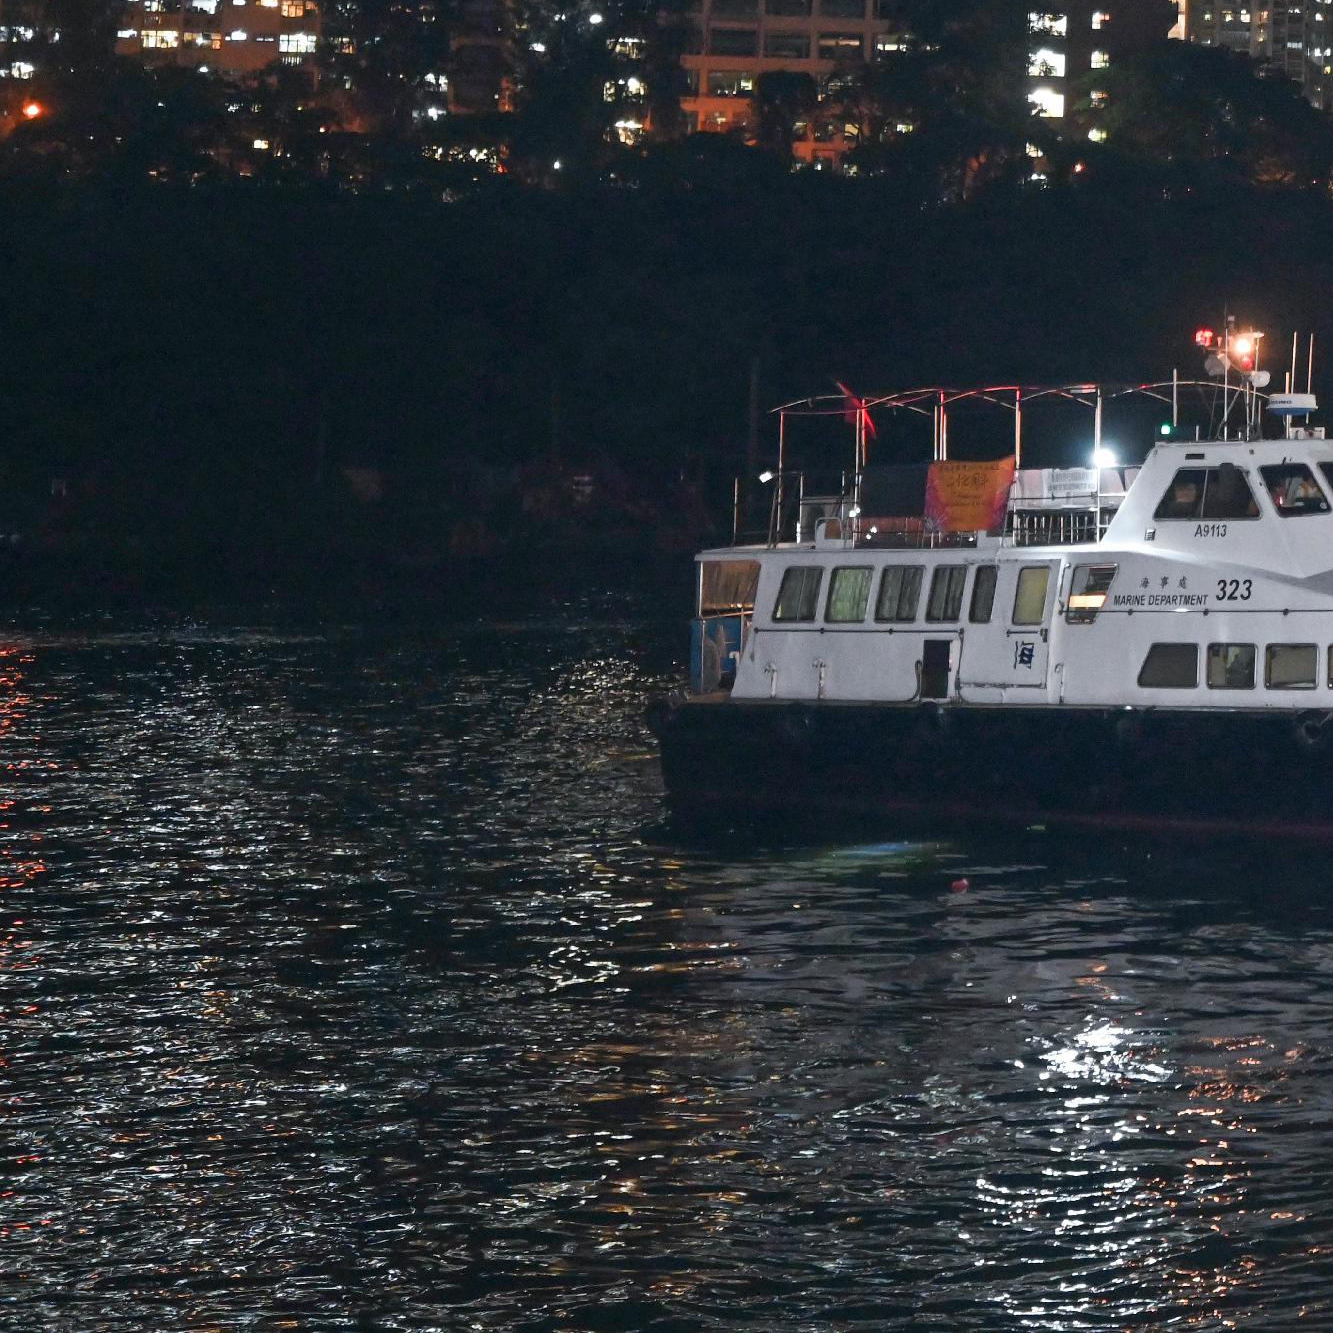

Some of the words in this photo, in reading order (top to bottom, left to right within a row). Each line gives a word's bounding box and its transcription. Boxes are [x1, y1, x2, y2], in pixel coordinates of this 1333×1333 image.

[1194, 524, 1227, 538] A9113
[1140, 575, 1187, 589] 海事處
[1215, 579, 1253, 601] 323
[1113, 594, 1145, 606] MARINE
[1148, 594, 1209, 606] DEPARTMENT
